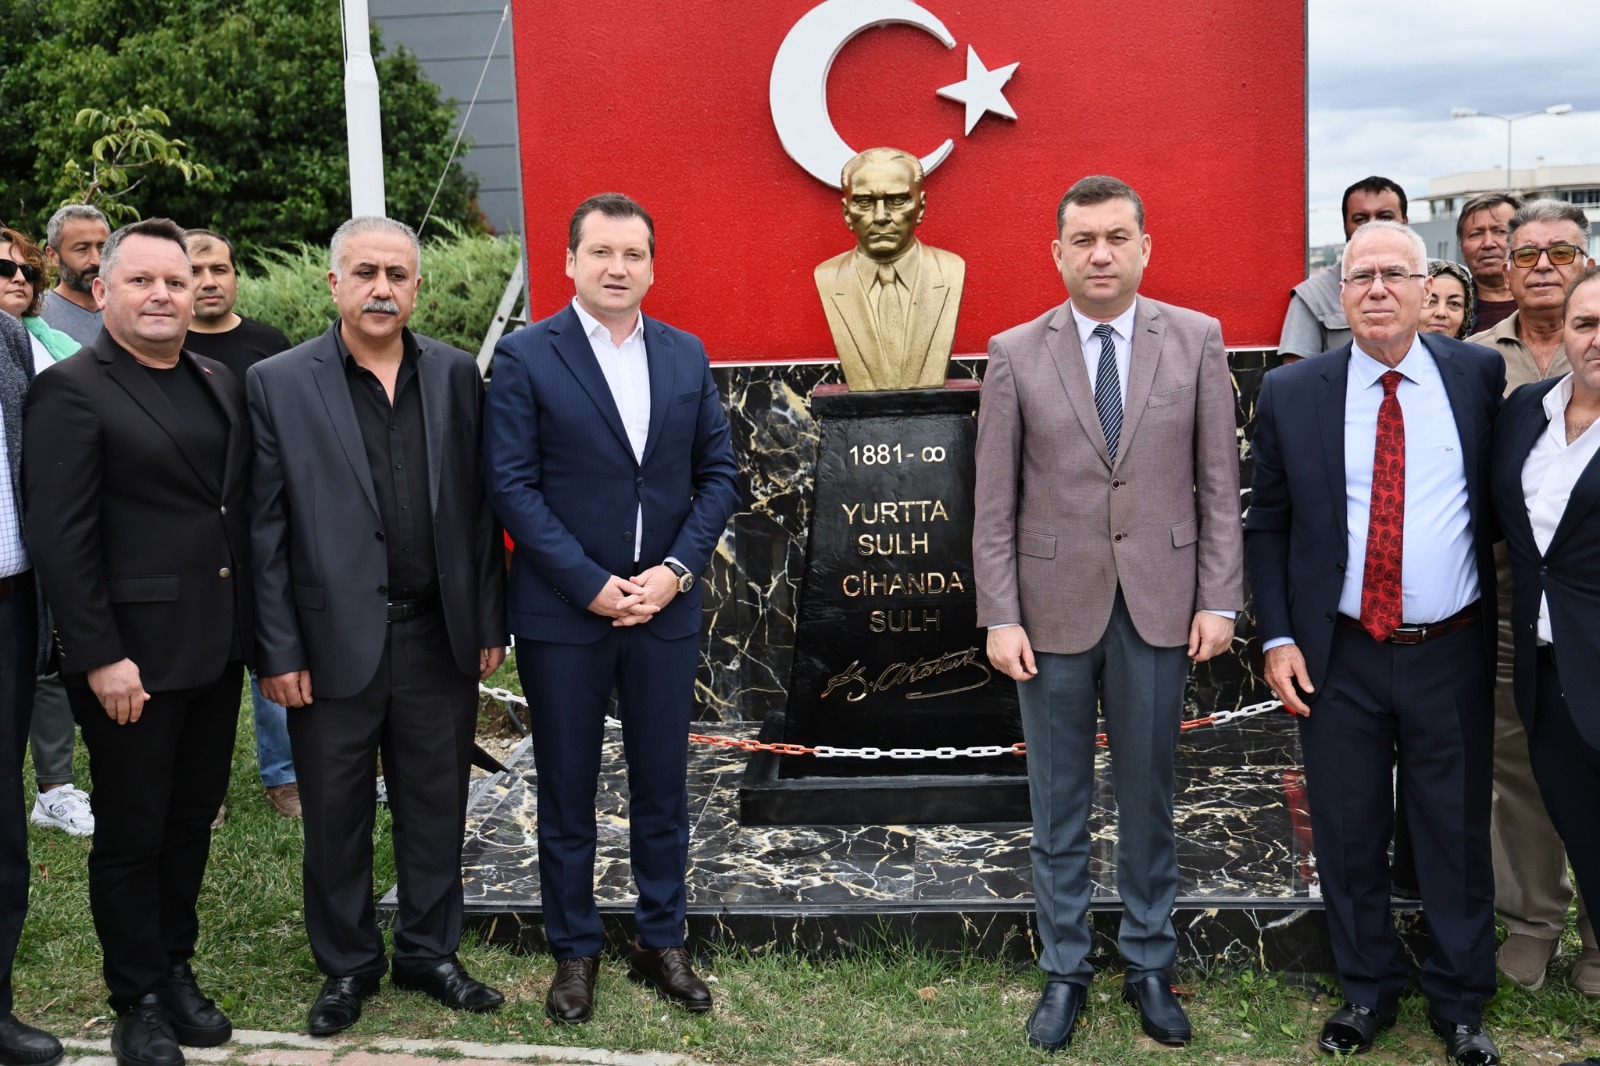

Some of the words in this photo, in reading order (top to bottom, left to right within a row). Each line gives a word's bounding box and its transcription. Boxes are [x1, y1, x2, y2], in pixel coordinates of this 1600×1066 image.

[841, 500, 949, 525] YURTTA
[858, 532, 929, 556] SULH
[842, 570, 965, 597] CİHANDA
[869, 609, 941, 633] SULH
